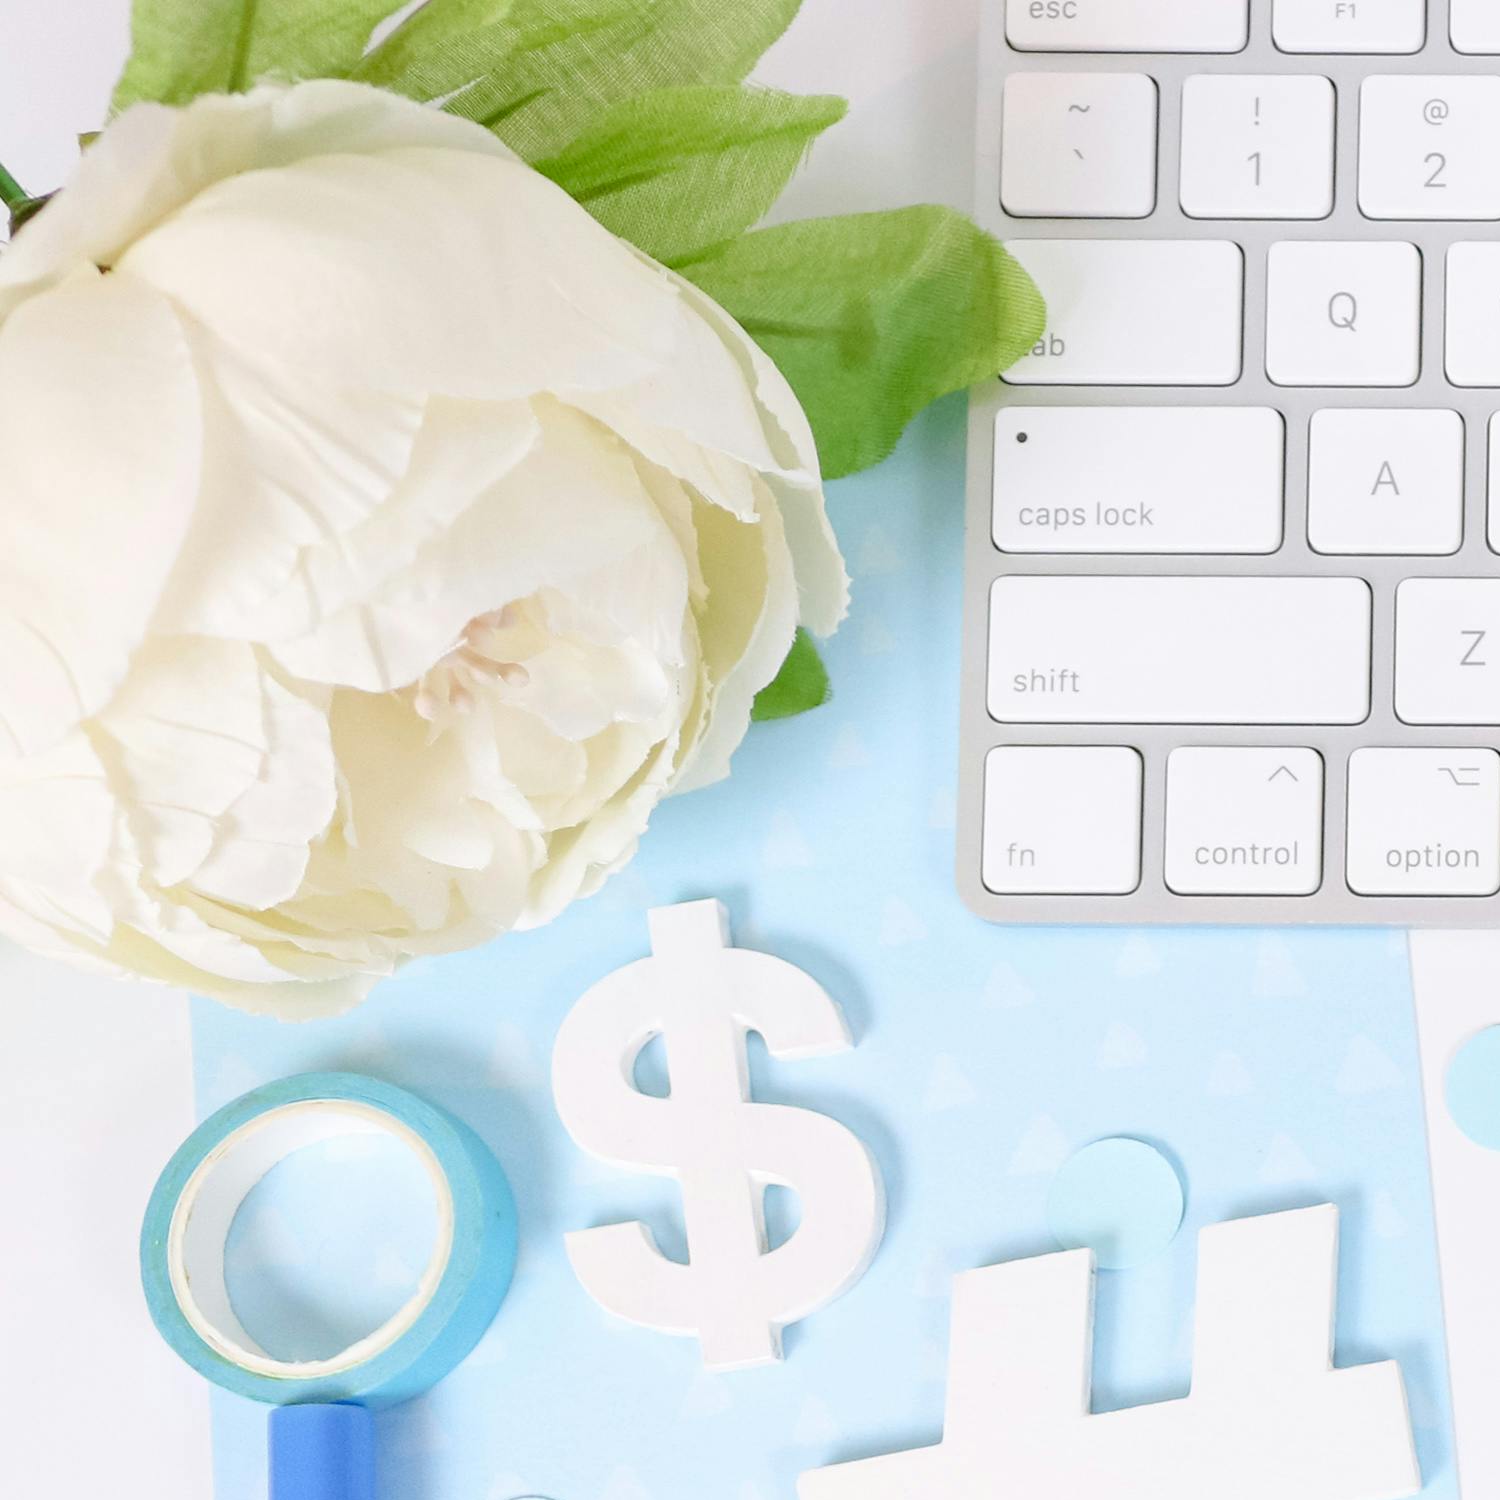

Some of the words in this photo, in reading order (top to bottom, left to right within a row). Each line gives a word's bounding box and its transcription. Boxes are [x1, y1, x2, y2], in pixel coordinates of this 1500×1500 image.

[1028, 0, 1077, 20] esc
[1335, 2, 1356, 19] F1
[1068, 104, 1091, 114] ~
[1253, 96, 1260, 127] !
[1422, 97, 1450, 127] @
[1247, 151, 1261, 187] 1
[1423, 151, 1447, 188] 2
[1327, 291, 1358, 333] Q
[1023, 333, 1066, 357] ab
[1370, 460, 1401, 496] A
[1018, 507, 1086, 531] caps
[1096, 501, 1154, 527] lock
[1459, 629, 1487, 667] Z
[1013, 668, 1080, 693] shift
[1007, 842, 1035, 867] fn
[1194, 840, 1298, 866] control
[1385, 842, 1480, 873] option
[550, 897, 888, 1374] $
